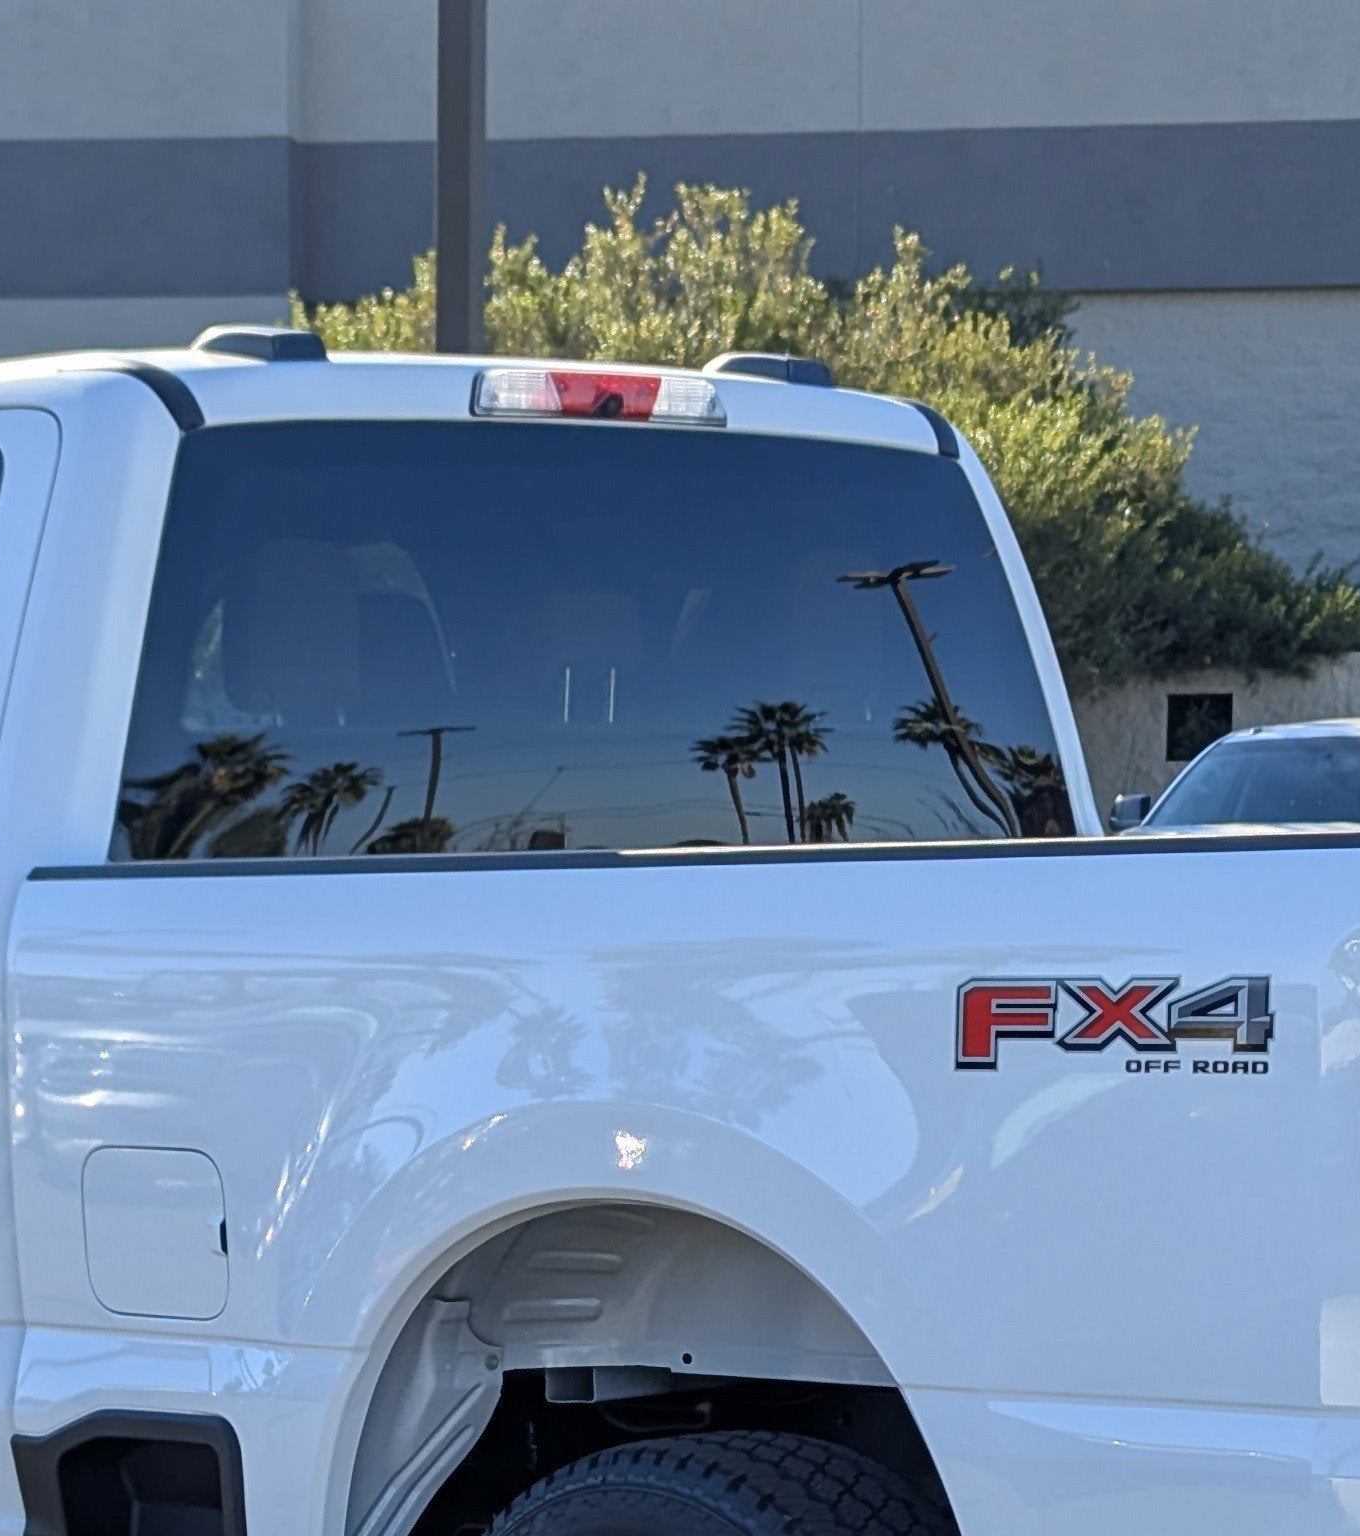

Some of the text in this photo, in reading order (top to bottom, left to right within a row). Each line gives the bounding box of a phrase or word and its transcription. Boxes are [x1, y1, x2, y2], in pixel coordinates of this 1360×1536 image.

[955, 974, 1276, 1071] FX4
[1125, 1059, 1270, 1075] OFF ROAD
